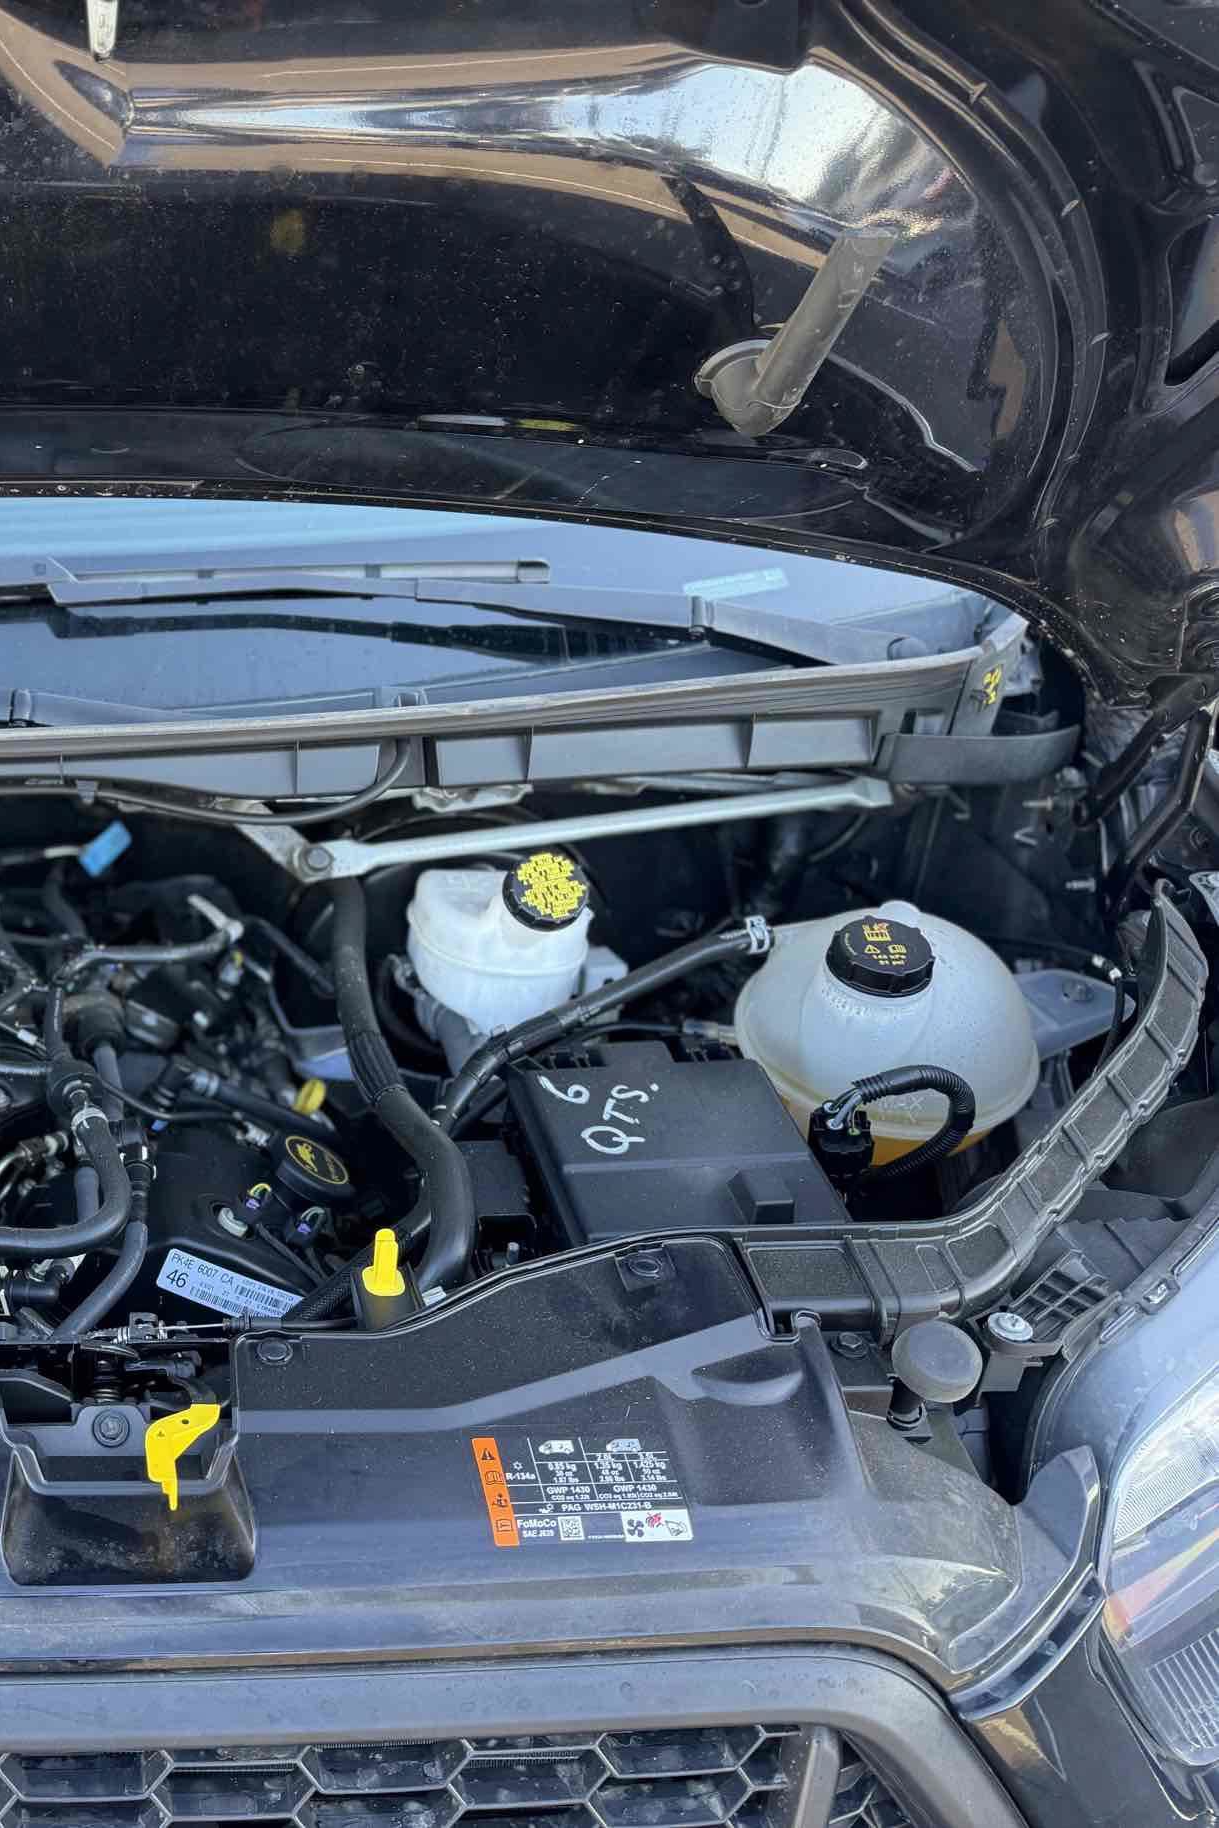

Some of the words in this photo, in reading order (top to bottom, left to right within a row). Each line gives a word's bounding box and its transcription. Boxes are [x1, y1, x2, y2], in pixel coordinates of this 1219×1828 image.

[537, 1074, 590, 1104] 6
[580, 1083, 659, 1154] QTS.
[166, 1269, 189, 1288] 46
[505, 1472, 536, 1480] R-134a
[546, 1486, 568, 1495] GWP
[570, 1485, 590, 1494] 1430
[613, 1484, 635, 1493] GWP
[636, 1484, 657, 1492] 1430
[561, 1503, 581, 1512] PAG
[516, 1518, 557, 1529] FoMoCo
[522, 1530, 537, 1538] SAE
